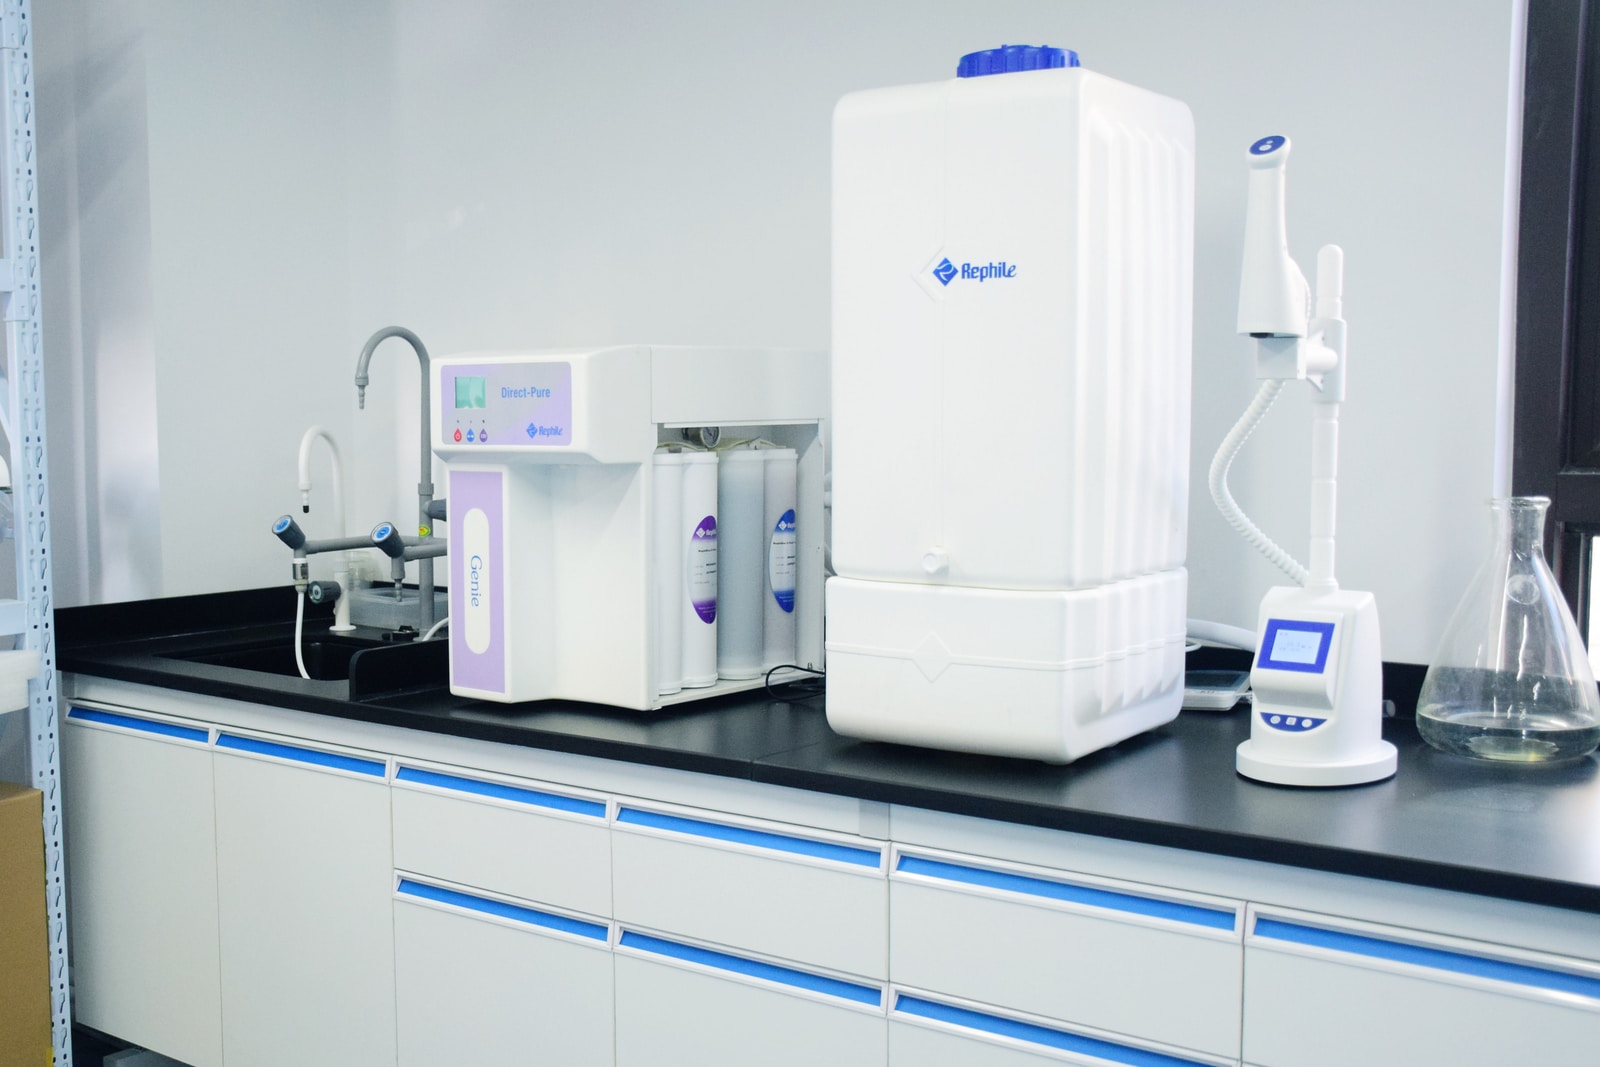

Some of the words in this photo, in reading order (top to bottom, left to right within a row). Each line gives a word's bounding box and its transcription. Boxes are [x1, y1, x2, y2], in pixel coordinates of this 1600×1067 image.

[961, 261, 1017, 282] Rephile
[501, 386, 551, 398] Direct-Pure
[471, 555, 482, 607] Genie
